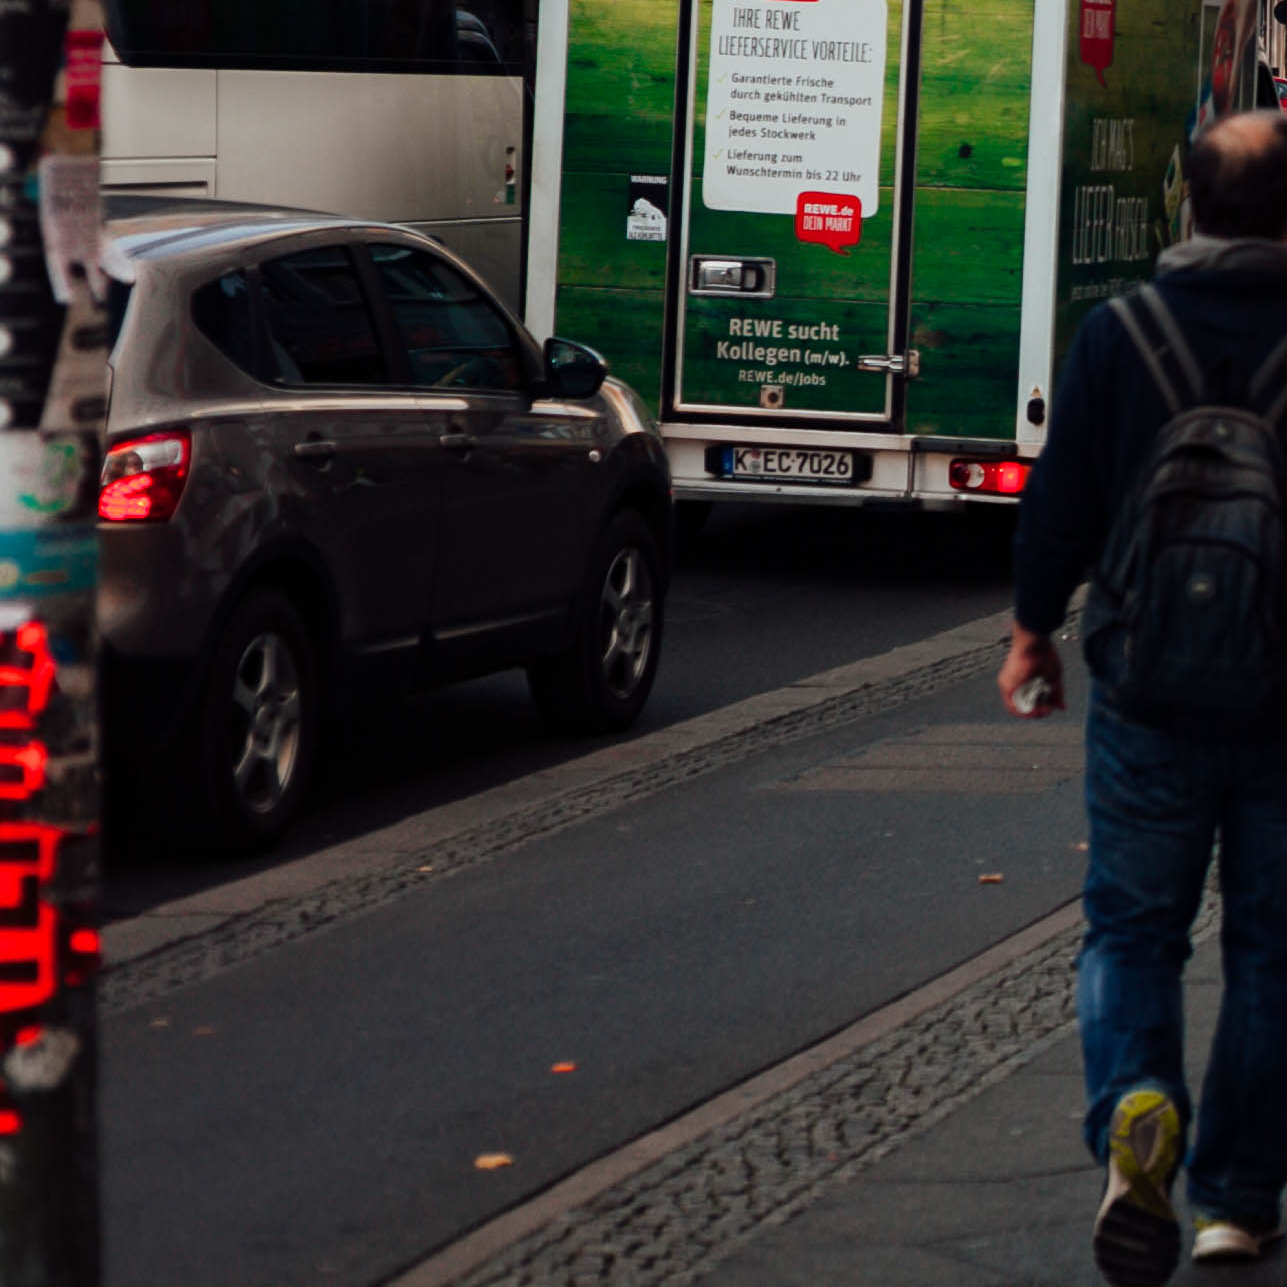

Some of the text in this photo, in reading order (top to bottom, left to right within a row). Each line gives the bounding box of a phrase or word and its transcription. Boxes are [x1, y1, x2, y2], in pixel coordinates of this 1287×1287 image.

[733, 7, 801, 31] IHRE REWE
[718, 35, 872, 63] LIEFERSERVICE VORTEILE:
[731, 73, 834, 89] Garantierte Frische
[730, 88, 872, 106] durch gekühlten Transport
[729, 110, 846, 127] Bequeme Lieferung in
[728, 126, 816, 141] jedes Stockwerk
[727, 149, 803, 163] Lieferung zum
[726, 165, 862, 182] Wunschtermin bis 22 Uhr
[803, 203, 854, 216] REWE.de
[803, 215, 854, 232] DEIN MARKT
[729, 318, 840, 341] REWE sucht
[716, 341, 800, 366] Kollegen
[738, 369, 826, 386] REWE.de/jobs
[734, 450, 750, 471] K
